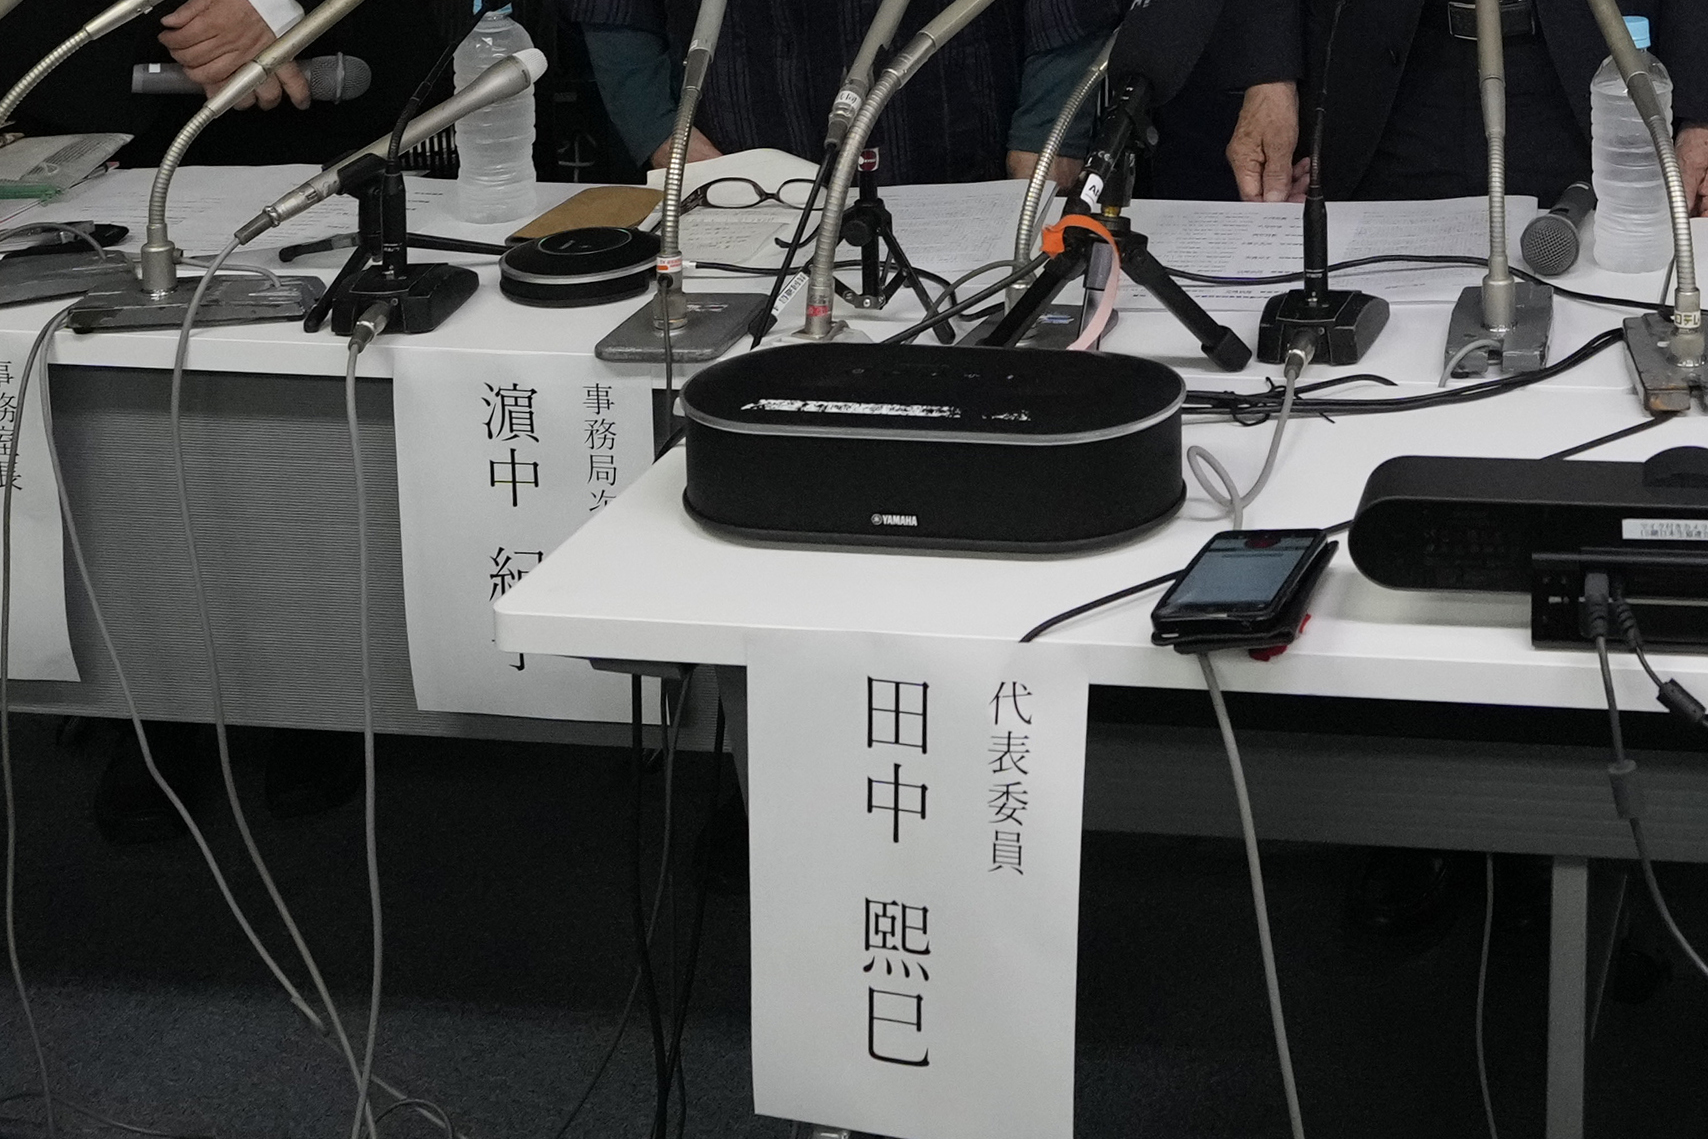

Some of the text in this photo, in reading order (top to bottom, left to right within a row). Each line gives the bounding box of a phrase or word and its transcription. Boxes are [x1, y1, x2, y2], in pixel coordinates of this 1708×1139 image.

[882, 514, 918, 526] YAMAHA
[866, 675, 930, 844] 田中
[987, 680, 1033, 875] 代表委員
